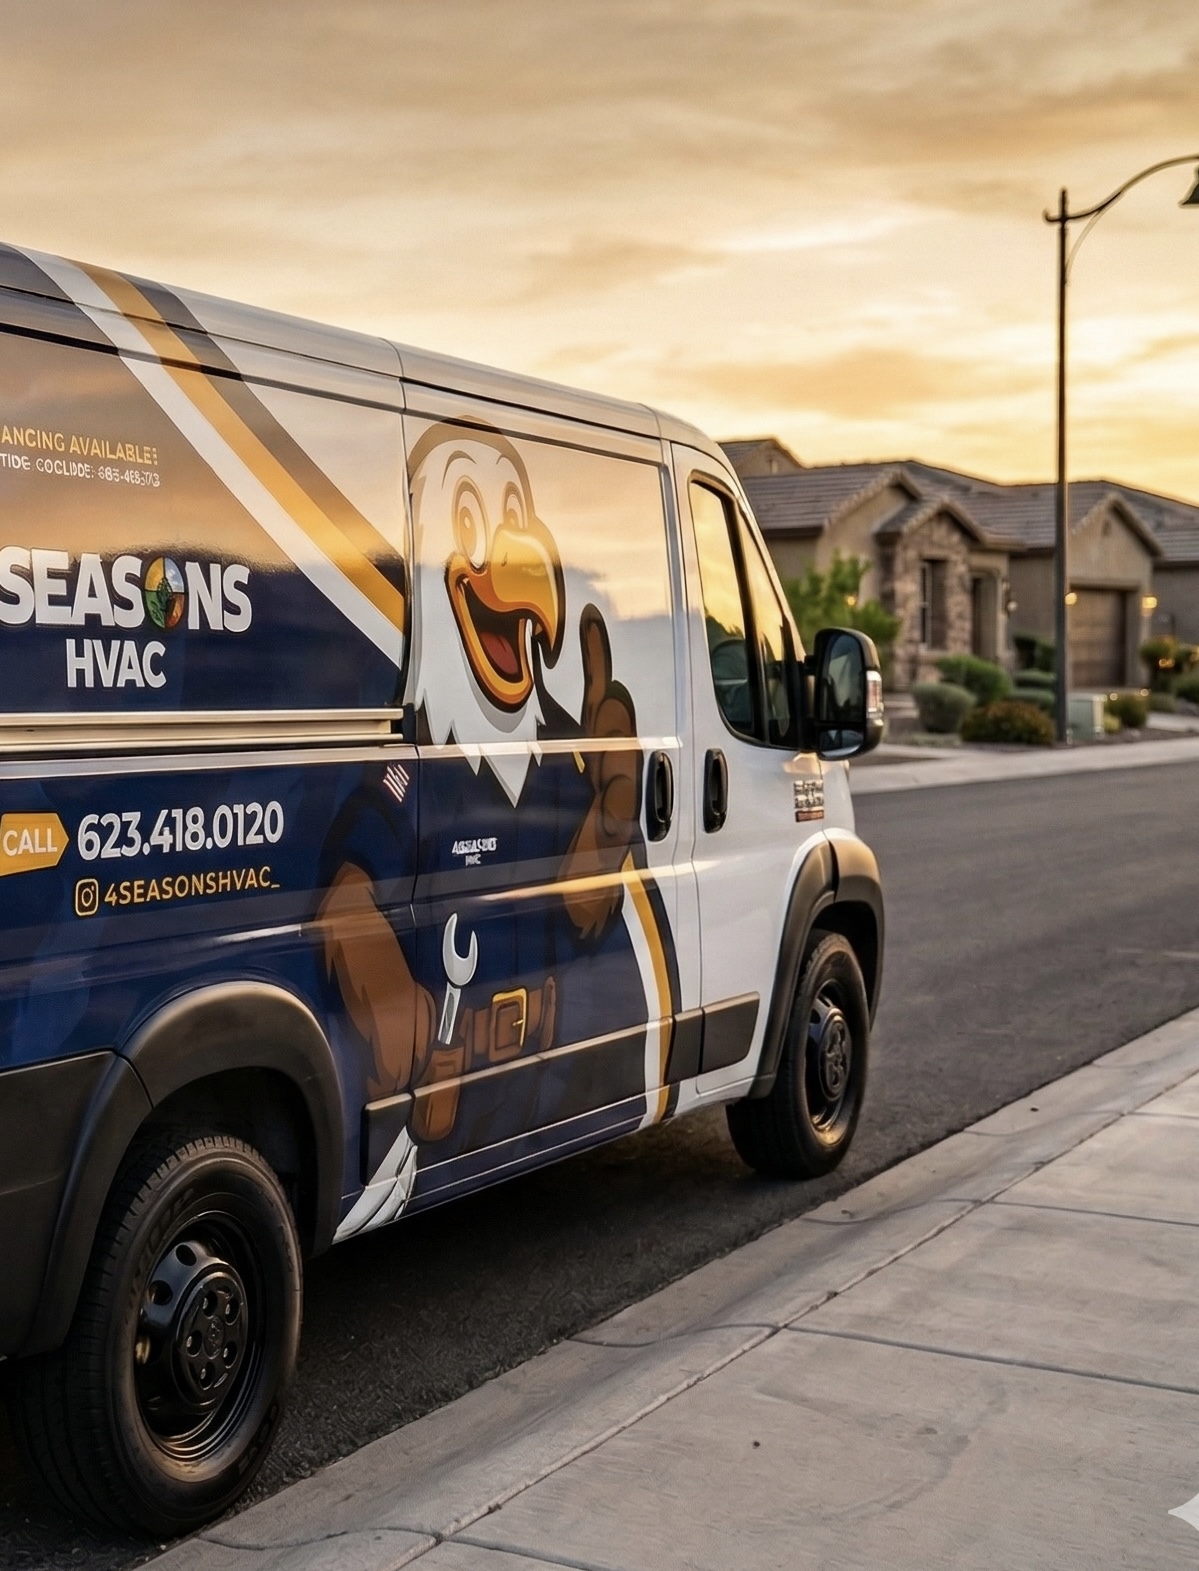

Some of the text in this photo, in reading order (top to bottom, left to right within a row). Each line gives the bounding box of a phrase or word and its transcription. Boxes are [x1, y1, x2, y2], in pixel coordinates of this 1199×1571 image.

[66, 638, 167, 689] HVAC
[2, 800, 284, 861] CALL 623.418.0120
[104, 865, 280, 906] 4SEASONSHVAC_
